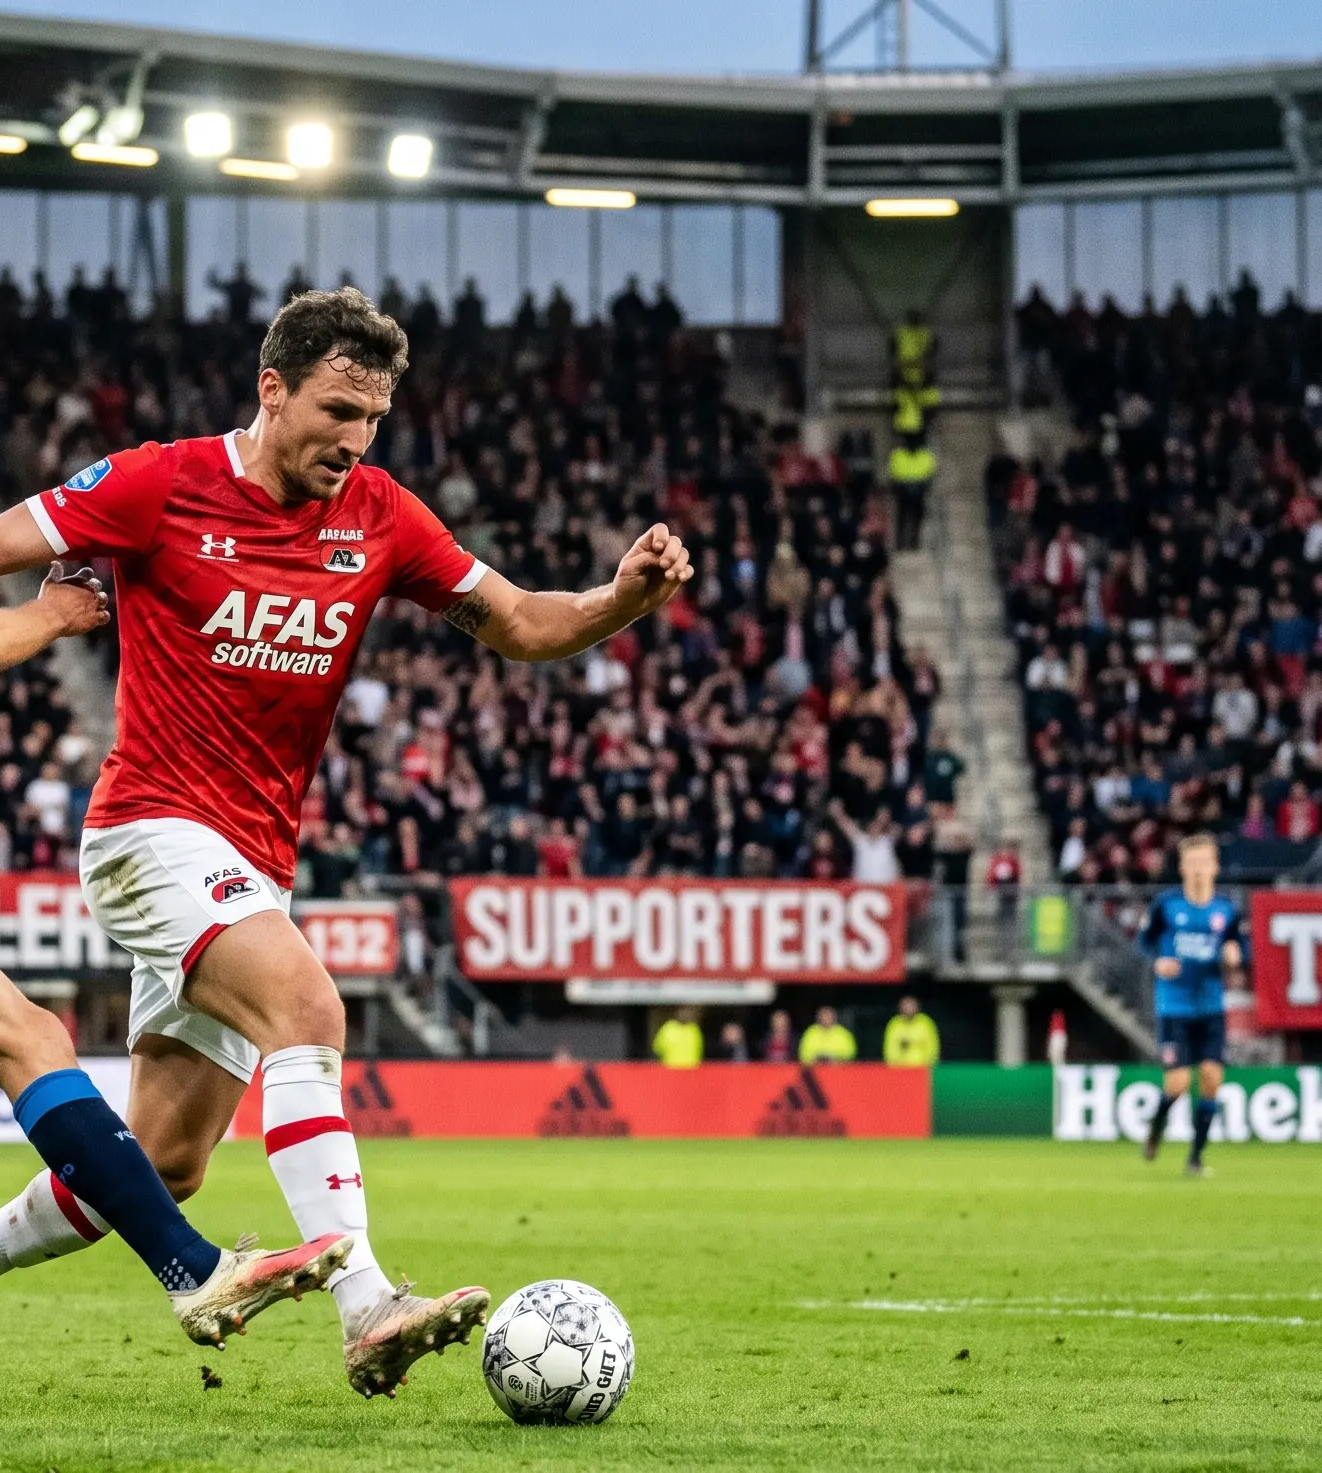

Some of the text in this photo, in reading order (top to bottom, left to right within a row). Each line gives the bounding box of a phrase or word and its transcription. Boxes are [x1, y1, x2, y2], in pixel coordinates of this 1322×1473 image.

[199, 589, 356, 649] AFAS
[211, 641, 333, 675] software
[204, 867, 242, 888] AFAS
[464, 886, 892, 972] SUPPORTERS
